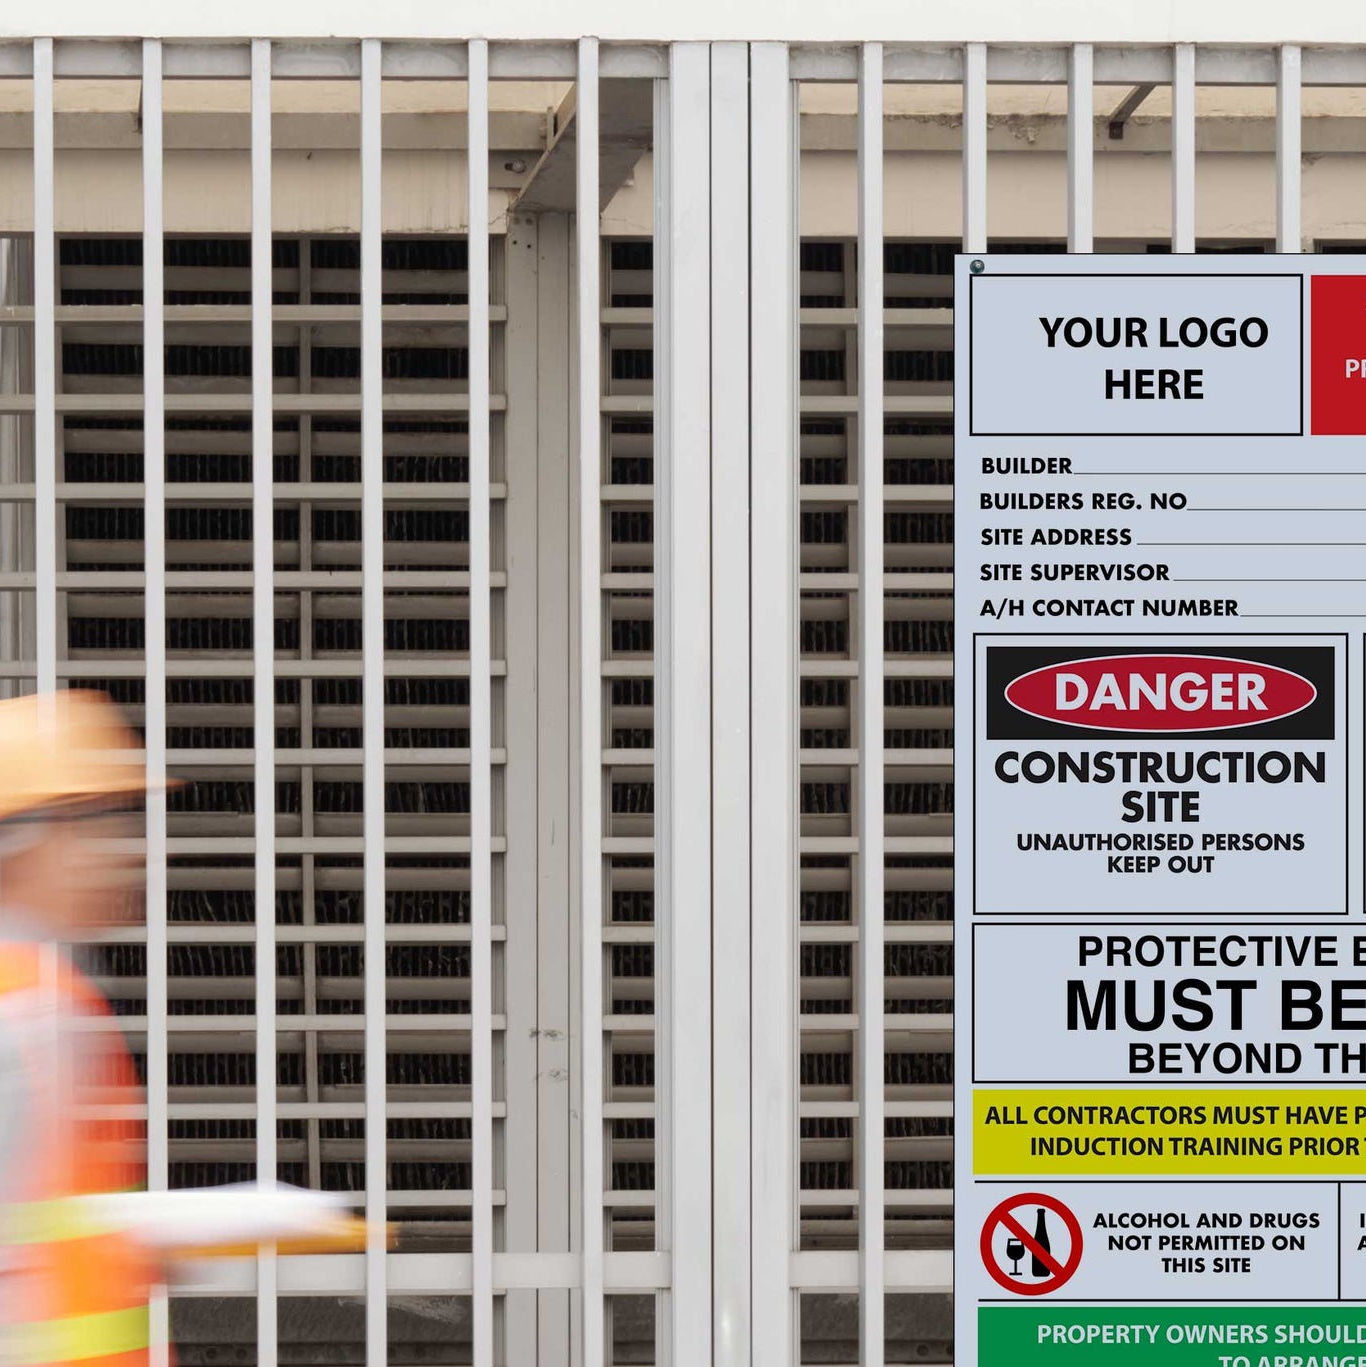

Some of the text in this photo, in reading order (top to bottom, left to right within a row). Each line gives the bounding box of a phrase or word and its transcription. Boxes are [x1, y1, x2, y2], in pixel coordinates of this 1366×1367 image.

[1038, 316, 1269, 348] YOUR LOGO
[1105, 368, 1204, 400] HERE
[981, 457, 1073, 475] BUILDER
[980, 492, 1188, 511] BUILDERS REG. NO
[980, 528, 1132, 546] SITE ADDRESS
[979, 563, 1170, 582] SITE SUPERVISOR
[979, 597, 1239, 620] A/H CONTACT NUMBER
[1054, 672, 1268, 712] DANGER
[994, 750, 1326, 784] CONSTRUCTION
[1121, 790, 1200, 824] SITE
[1017, 832, 1305, 852] UNAUTHORISED PERSONS
[1107, 855, 1215, 874] KEEP OUT
[1079, 934, 1339, 968] PROTECTIVE
[1066, 978, 1258, 1032] MUST
[1129, 1041, 1302, 1075] BEYOND
[984, 1106, 1029, 1125] ALL
[1033, 1105, 1207, 1125] CONTRACTORS
[1212, 1105, 1280, 1125] MUST
[1285, 1106, 1348, 1125] HAVE
[1031, 1136, 1164, 1156] INDUCTION
[1168, 1137, 1283, 1156] TRAINING
[1289, 1136, 1360, 1156] PRIOR
[1092, 1212, 1320, 1229] ALCOHOL AND DRUGS
[1108, 1234, 1305, 1251] NOT PERMITTED ON
[1161, 1257, 1251, 1274] THIS SITE
[1037, 1324, 1160, 1344] PROPERTY
[1166, 1324, 1269, 1344] OWNERS
